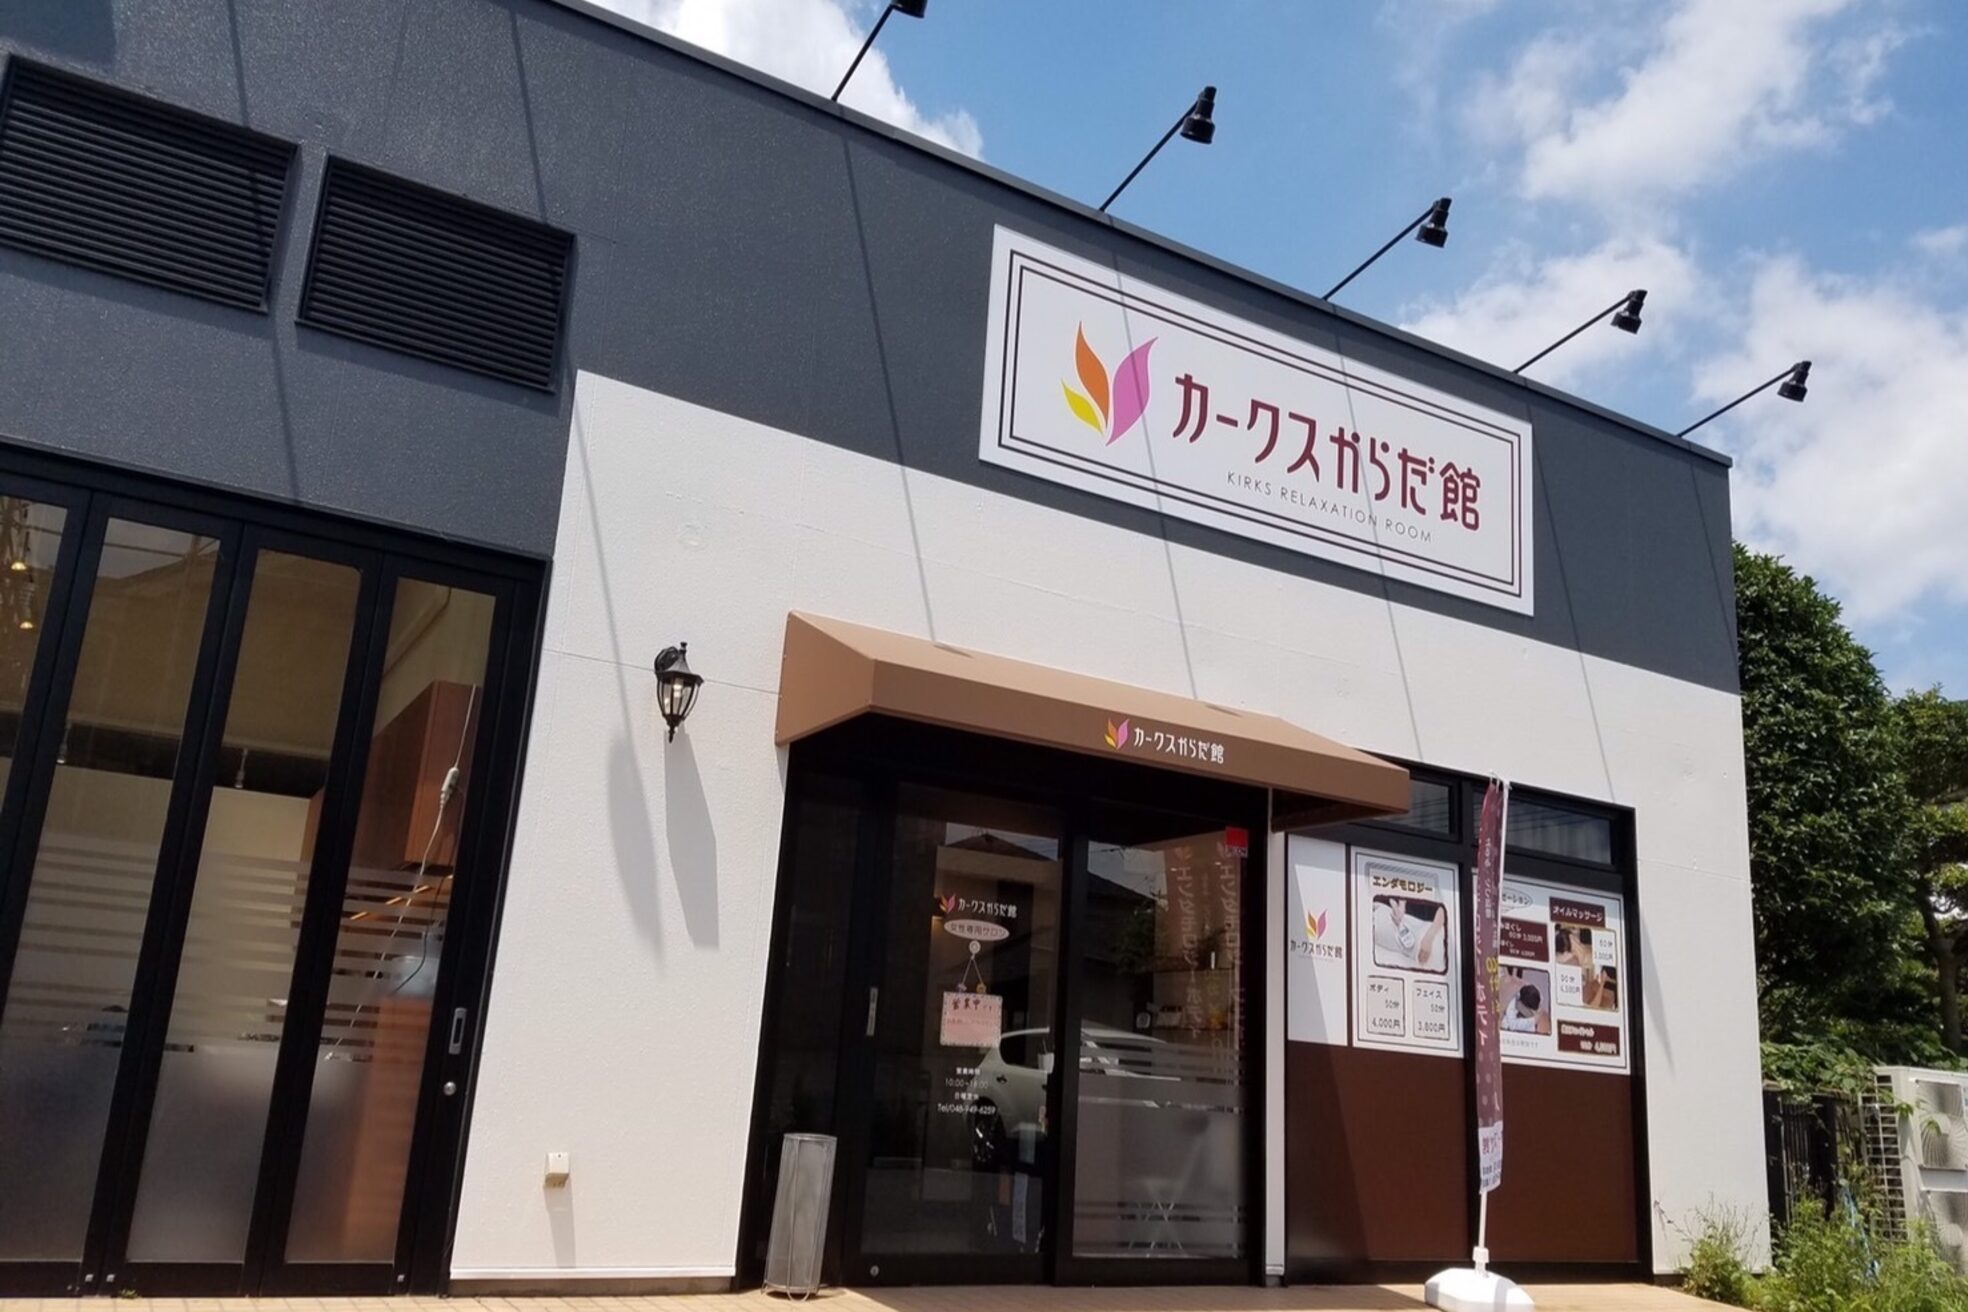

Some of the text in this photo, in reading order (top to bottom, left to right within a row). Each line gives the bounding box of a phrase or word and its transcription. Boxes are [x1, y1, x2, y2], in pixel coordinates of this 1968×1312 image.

[1173, 373, 1481, 531] カークスからだ館
[1227, 471, 1432, 543] KIRKS RELAXATION ROOM
[1133, 727, 1225, 764] カークスからだ館
[1373, 875, 1433, 894] エンダモロジー
[958, 898, 1018, 918] カークスからだ館
[1552, 905, 1603, 922] オイルマッサージ
[1290, 939, 1343, 959] カークスからだ館
[1369, 983, 1389, 993] ボディ
[1416, 987, 1442, 1000] フェイス
